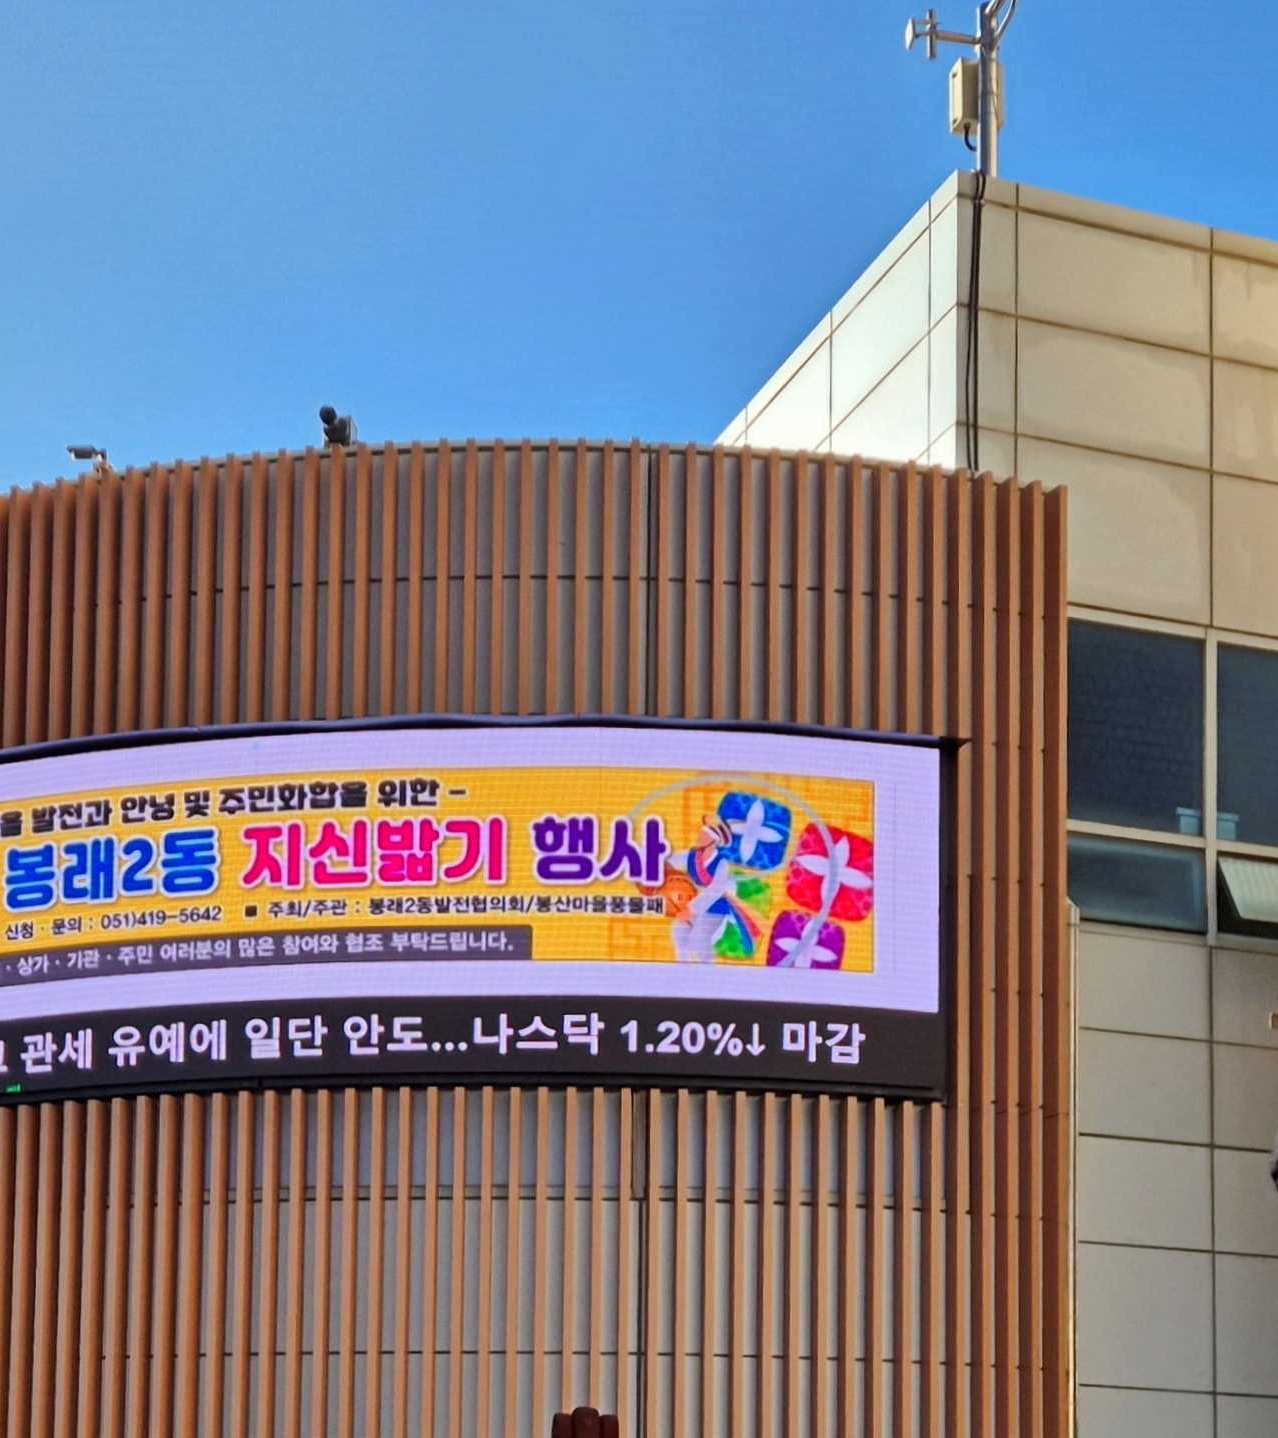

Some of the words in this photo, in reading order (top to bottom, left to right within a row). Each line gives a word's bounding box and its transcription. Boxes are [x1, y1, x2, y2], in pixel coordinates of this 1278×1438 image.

[32, 799, 112, 835] 발전과
[121, 792, 176, 825] 안녕
[184, 789, 210, 818] 및
[219, 780, 368, 815] 주민화합을
[378, 777, 440, 808] 위한
[5, 828, 218, 910] 봉래2동
[242, 817, 505, 887] 지신밟기
[532, 816, 667, 882] 행사
[5, 921, 34, 941] 신청
[51, 917, 82, 936] 문의
[100, 905, 223, 931] 051)419-5642
[267, 898, 347, 919] 주최/주관
[17, 954, 50, 976] 상가
[67, 950, 100, 970] 기관
[117, 945, 153, 966] 주민
[160, 938, 231, 963] 여러분의
[238, 935, 274, 957] 많은
[282, 933, 339, 956] 참여와
[345, 931, 383, 954] 협조
[390, 930, 514, 953] 부탁드립니다.
[21, 1028, 93, 1074] 관세
[108, 1019, 227, 1068] 유예에
[244, 1015, 328, 1061] 일단
[782, 1020, 866, 1065] 마감
